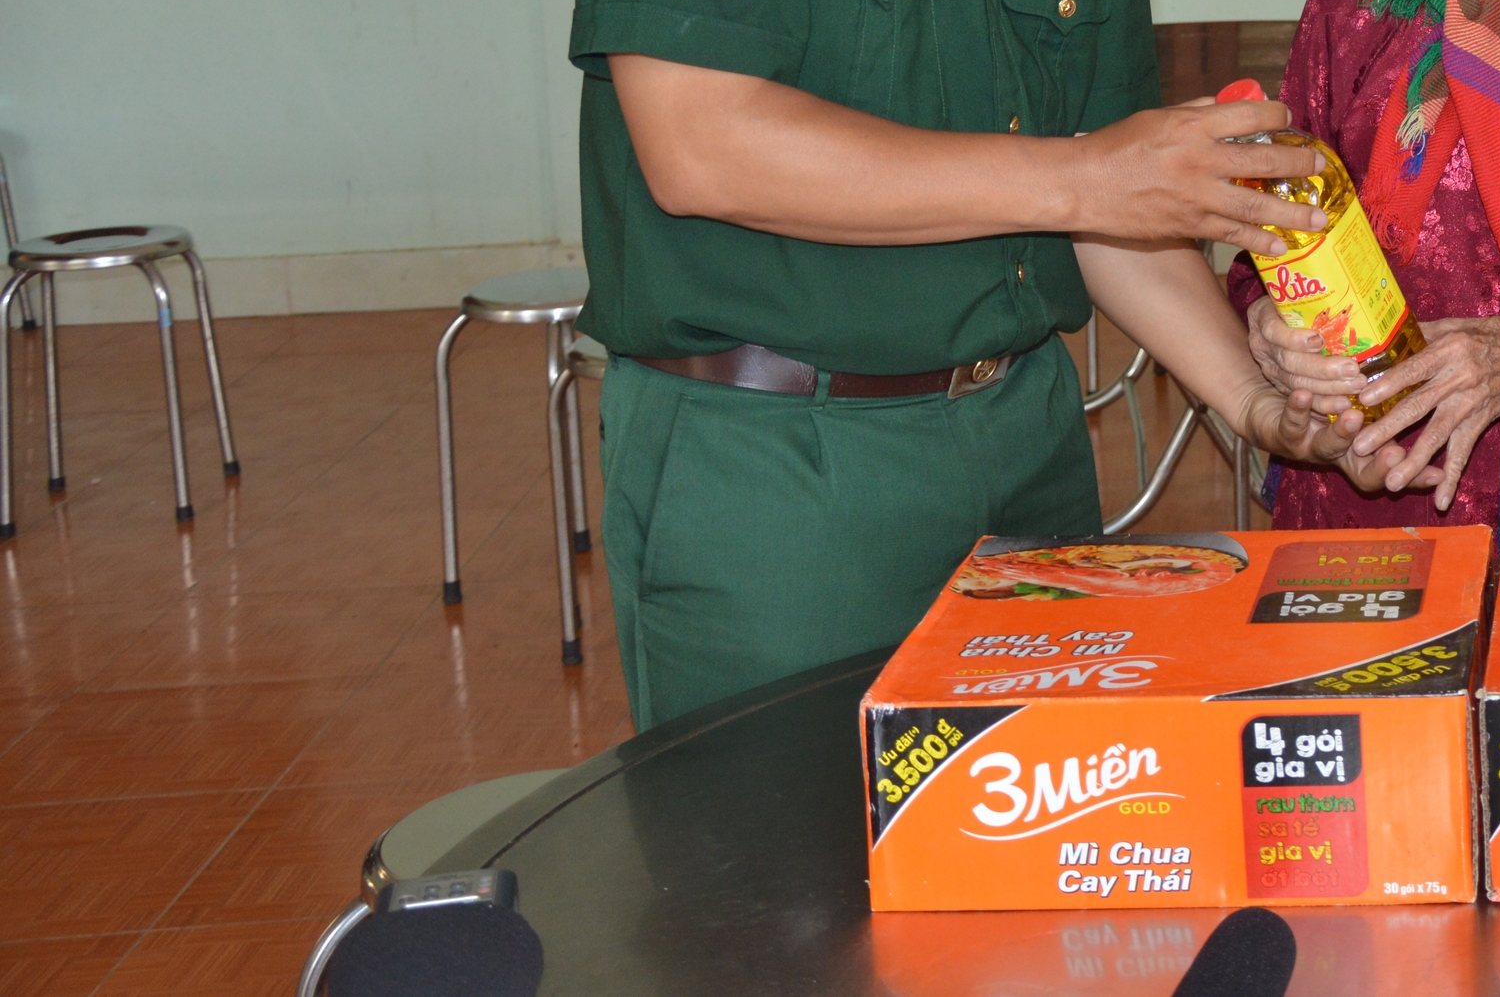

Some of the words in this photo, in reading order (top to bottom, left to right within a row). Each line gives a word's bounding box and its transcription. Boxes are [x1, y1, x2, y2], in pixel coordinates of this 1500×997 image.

[1058, 630, 1135, 642] Cay
[958, 645, 1061, 658] Chua
[1254, 722, 1286, 757] 4
[1295, 728, 1344, 758] gói
[877, 733, 949, 803] 3.500
[1254, 756, 1305, 783] gia
[1314, 755, 1346, 783] vị
[1119, 801, 1171, 815] GOLD
[1256, 797, 1296, 814] rau
[1298, 793, 1356, 813] thơm
[1258, 821, 1289, 838] sa
[1293, 816, 1320, 838] tế
[1058, 841, 1100, 866] Mì
[1109, 841, 1193, 865] Chua
[1259, 841, 1303, 865] gia
[1308, 840, 1333, 865] vị
[1058, 869, 1119, 898] Cay
[1123, 868, 1193, 892] Thái
[1294, 867, 1340, 892] bột
[1383, 882, 1399, 894] 30
[1399, 883, 1415, 895] gói
[1416, 884, 1424, 894] x
